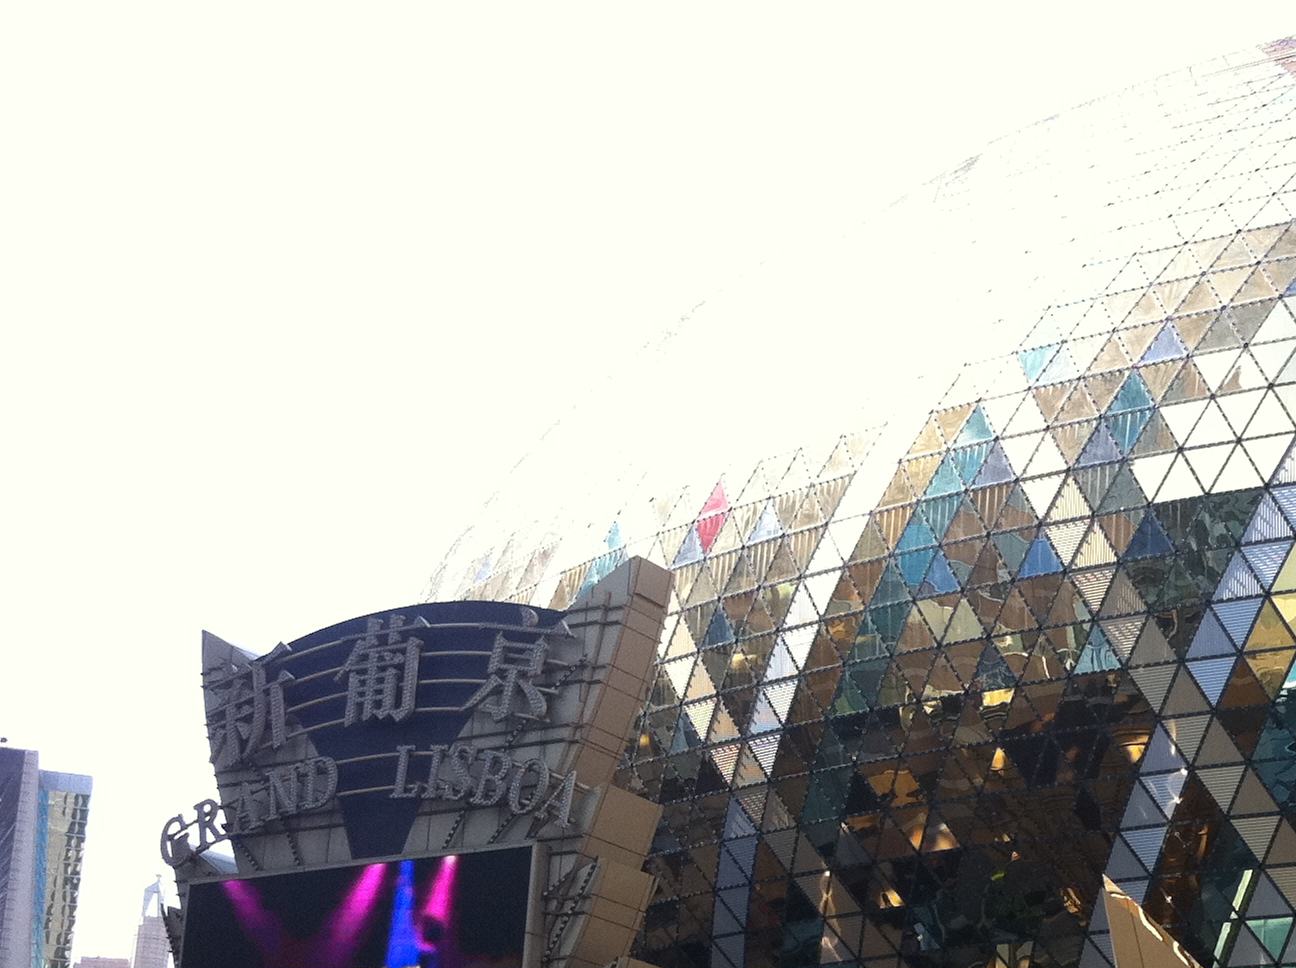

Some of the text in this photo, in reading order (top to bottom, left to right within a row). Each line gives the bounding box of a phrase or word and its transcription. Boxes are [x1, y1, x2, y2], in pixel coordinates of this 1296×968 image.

[205, 608, 577, 767] 新葡京
[160, 744, 577, 868] GRAND LISBOA
